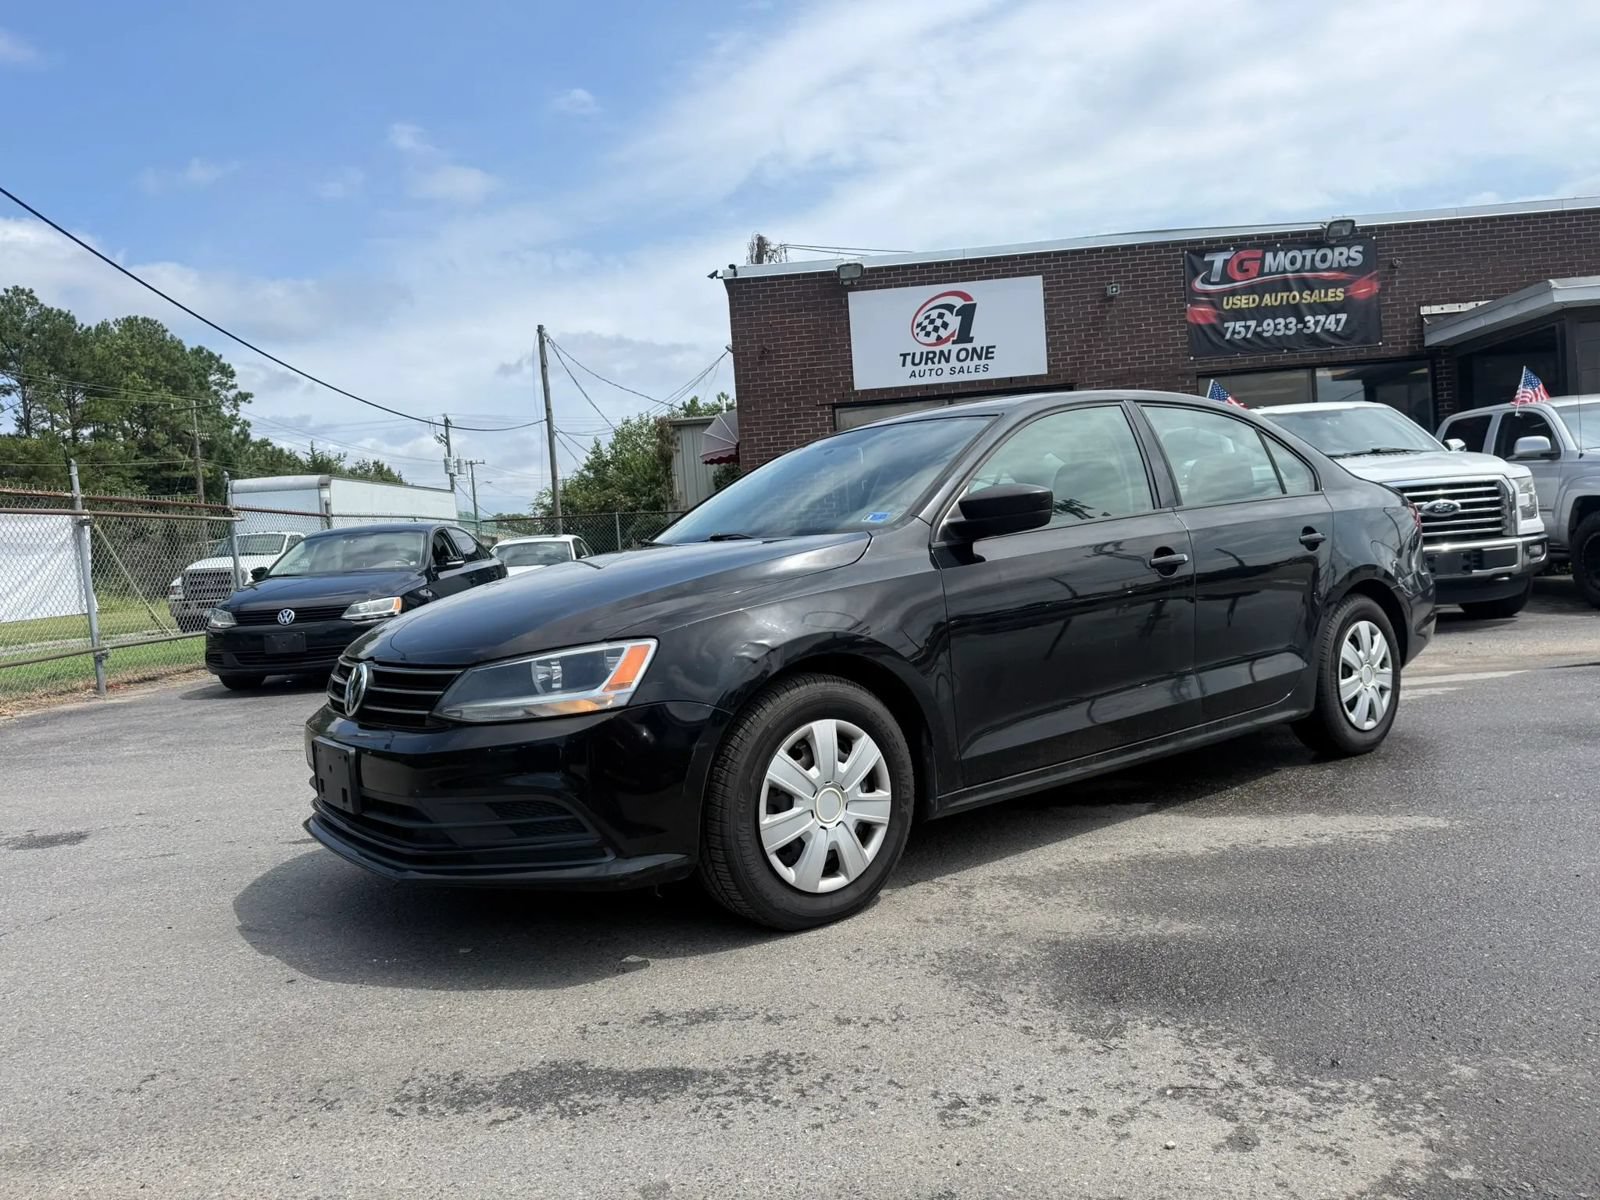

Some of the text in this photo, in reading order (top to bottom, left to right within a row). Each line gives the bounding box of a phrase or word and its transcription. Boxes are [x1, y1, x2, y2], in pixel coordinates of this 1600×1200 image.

[1204, 245, 1364, 282] TG MOTORS
[1223, 288, 1345, 310] USED AUTO SALES
[1223, 313, 1348, 341] 757-933-3747
[899, 345, 997, 368] TURN ONE
[908, 363, 990, 379] AUTO SALES
